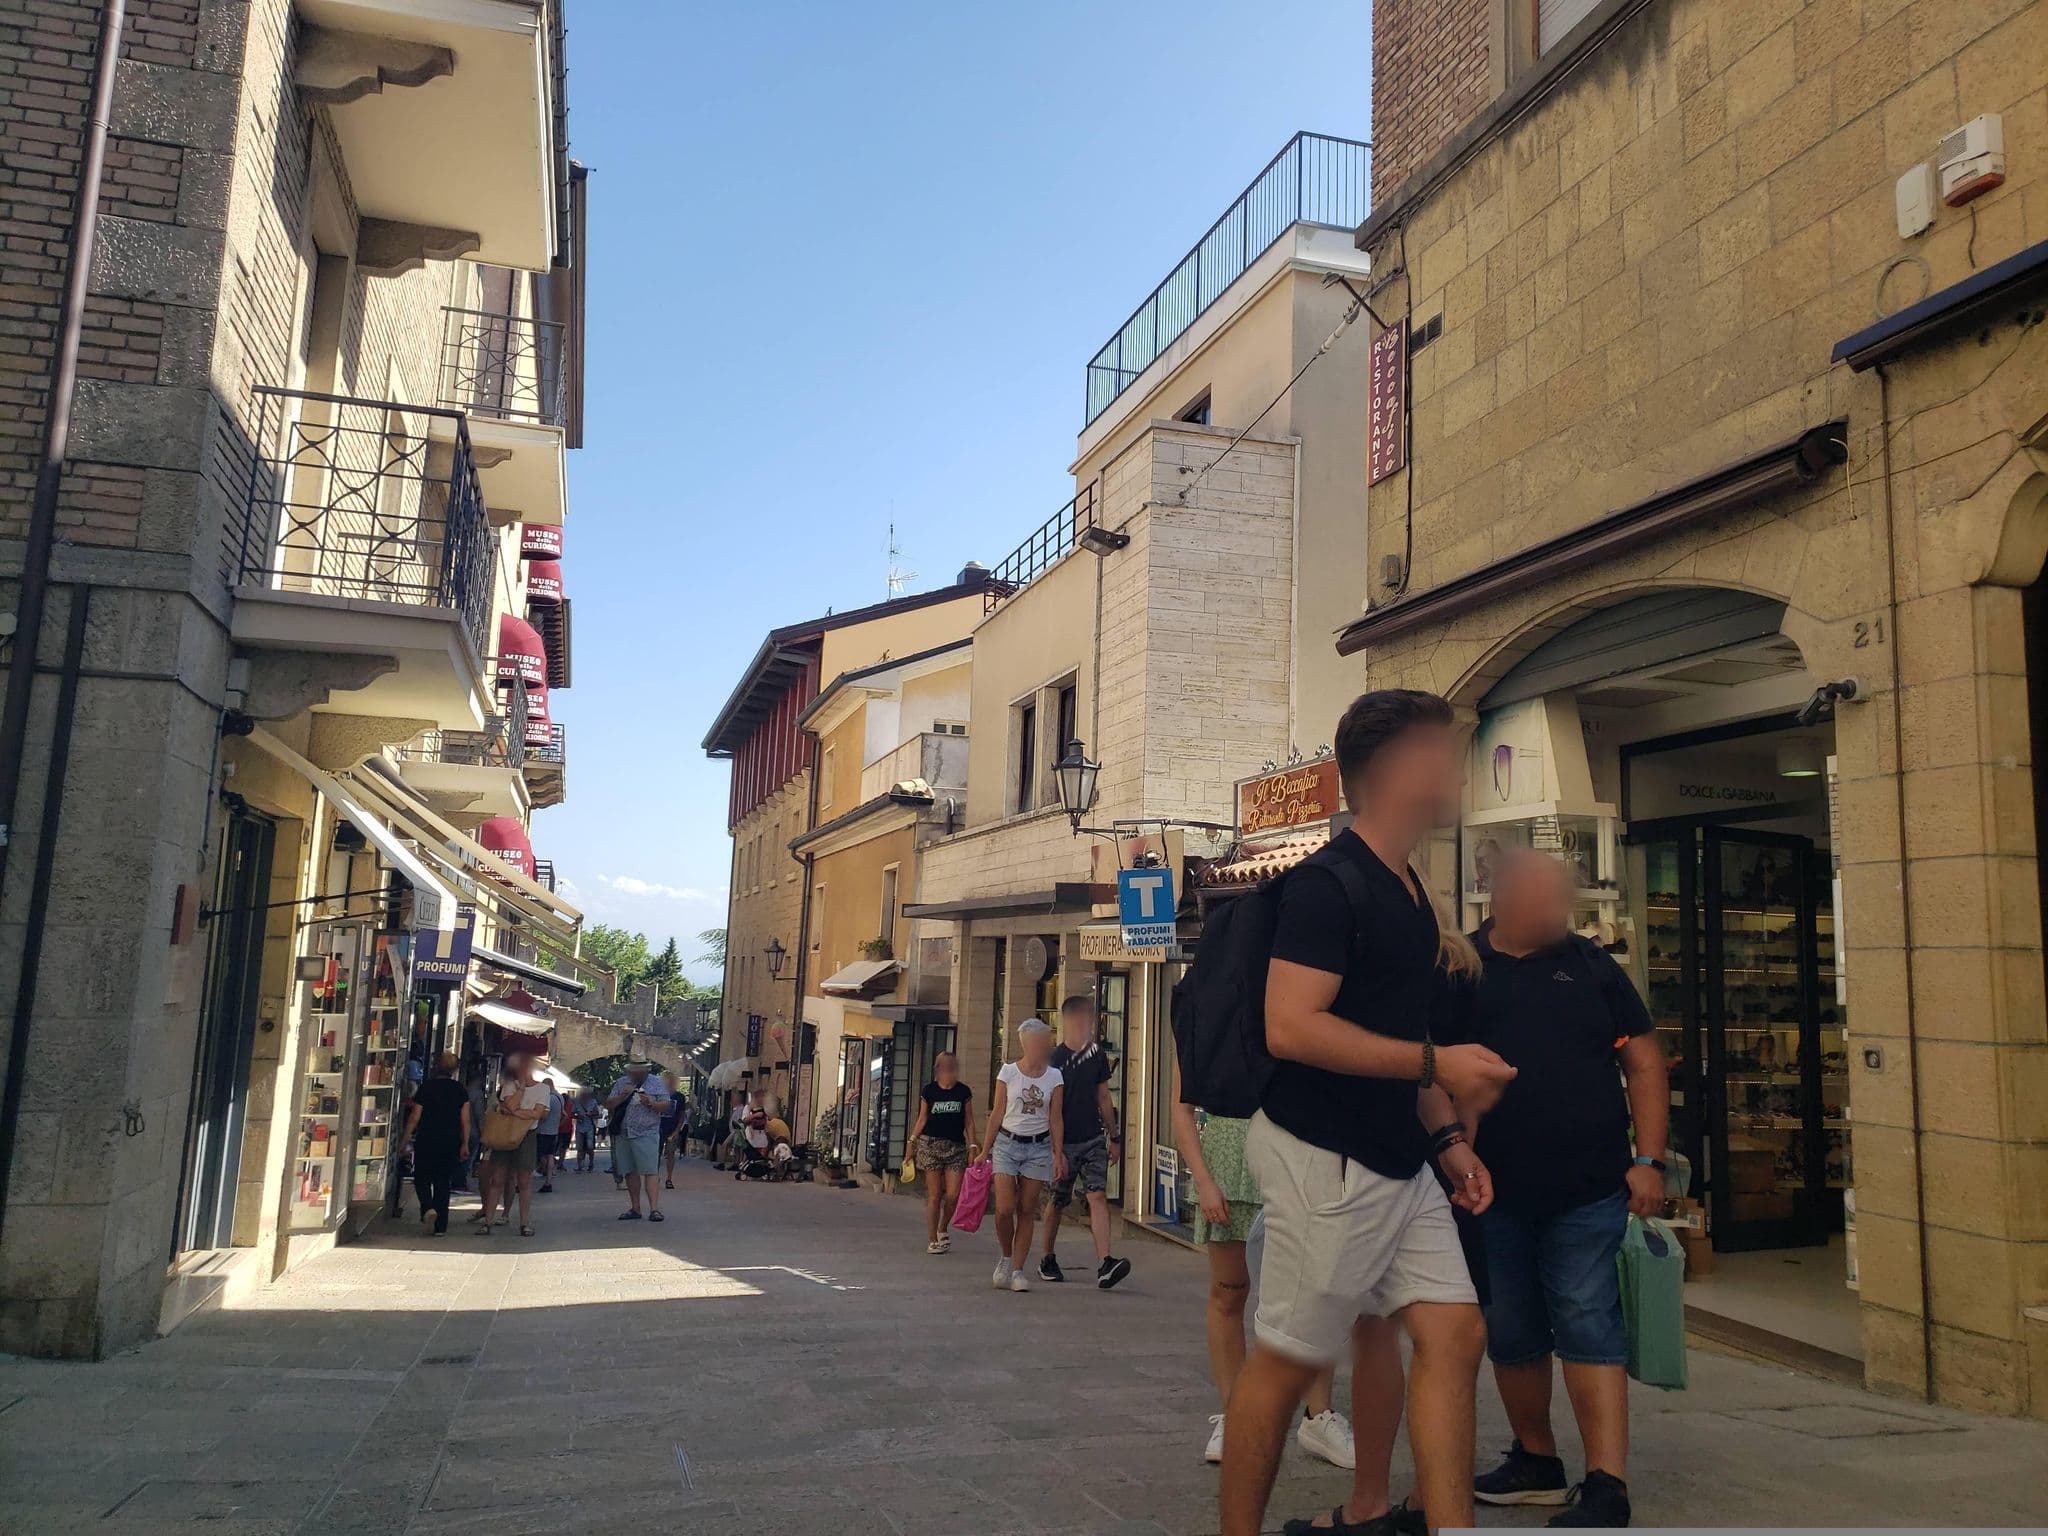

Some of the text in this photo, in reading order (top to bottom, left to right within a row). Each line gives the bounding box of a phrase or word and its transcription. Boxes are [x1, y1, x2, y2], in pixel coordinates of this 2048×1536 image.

[1372, 341, 1382, 480] RISTORANTE
[527, 529, 559, 541] MUSEO
[531, 577, 559, 588] MUSEO
[1854, 616, 1885, 648] 21
[1270, 768, 1320, 805] Beccafico
[1679, 783, 1714, 799] DOLCE
[1722, 787, 1777, 802] GABBANA
[1248, 799, 1322, 832] Ristorante Pizzeria
[1129, 876, 1163, 918] T
[1127, 926, 1171, 936] PROFUMI
[1127, 936, 1174, 946] TABACCHI
[416, 960, 466, 975] PROFUMI
[750, 1016, 758, 1055] HOTEL
